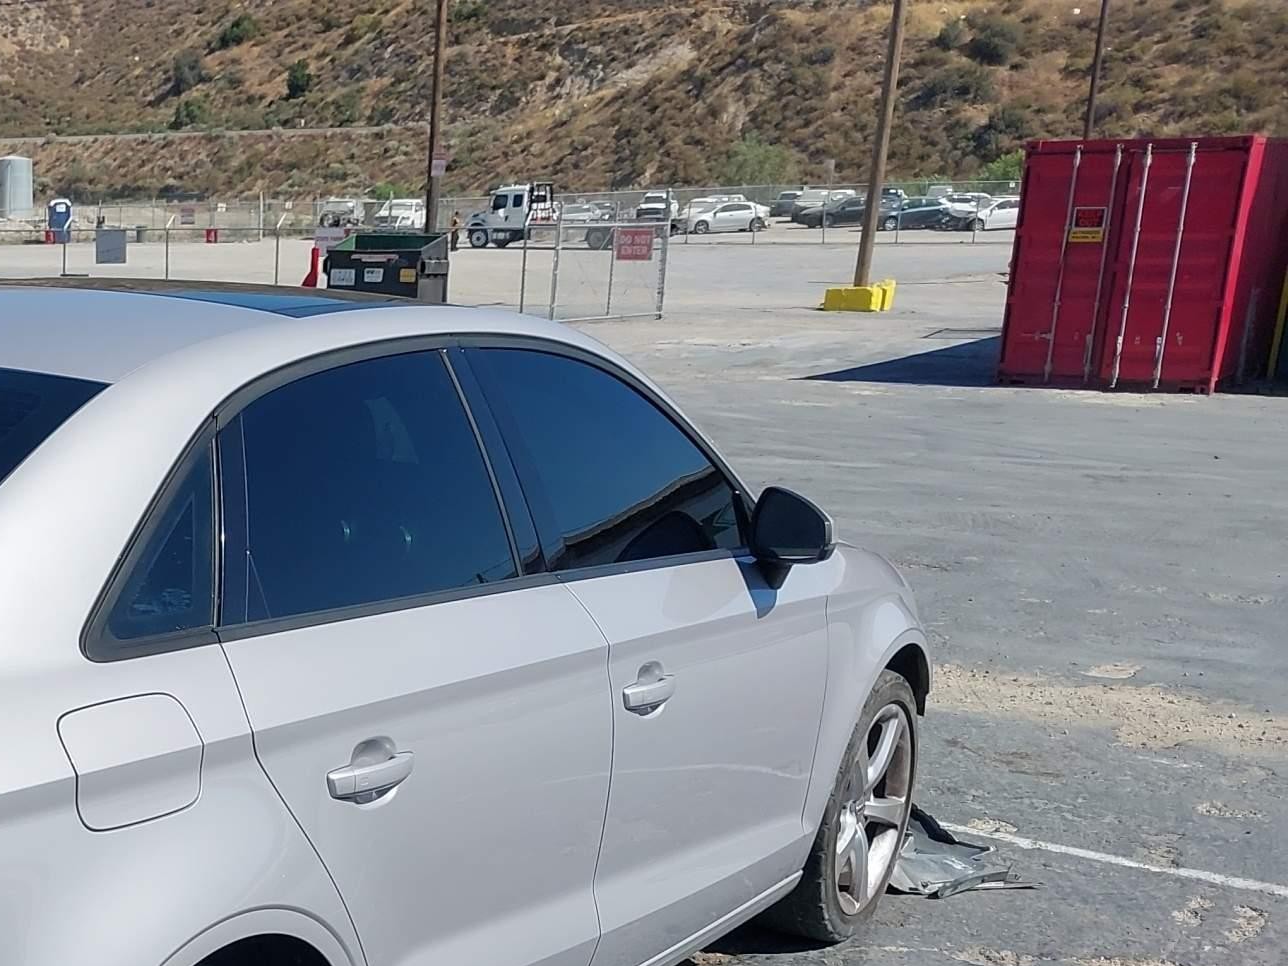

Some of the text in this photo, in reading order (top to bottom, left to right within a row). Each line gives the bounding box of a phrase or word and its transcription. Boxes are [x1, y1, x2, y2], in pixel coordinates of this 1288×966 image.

[620, 234, 650, 245] DO NOT
[620, 246, 648, 255] ENTER
